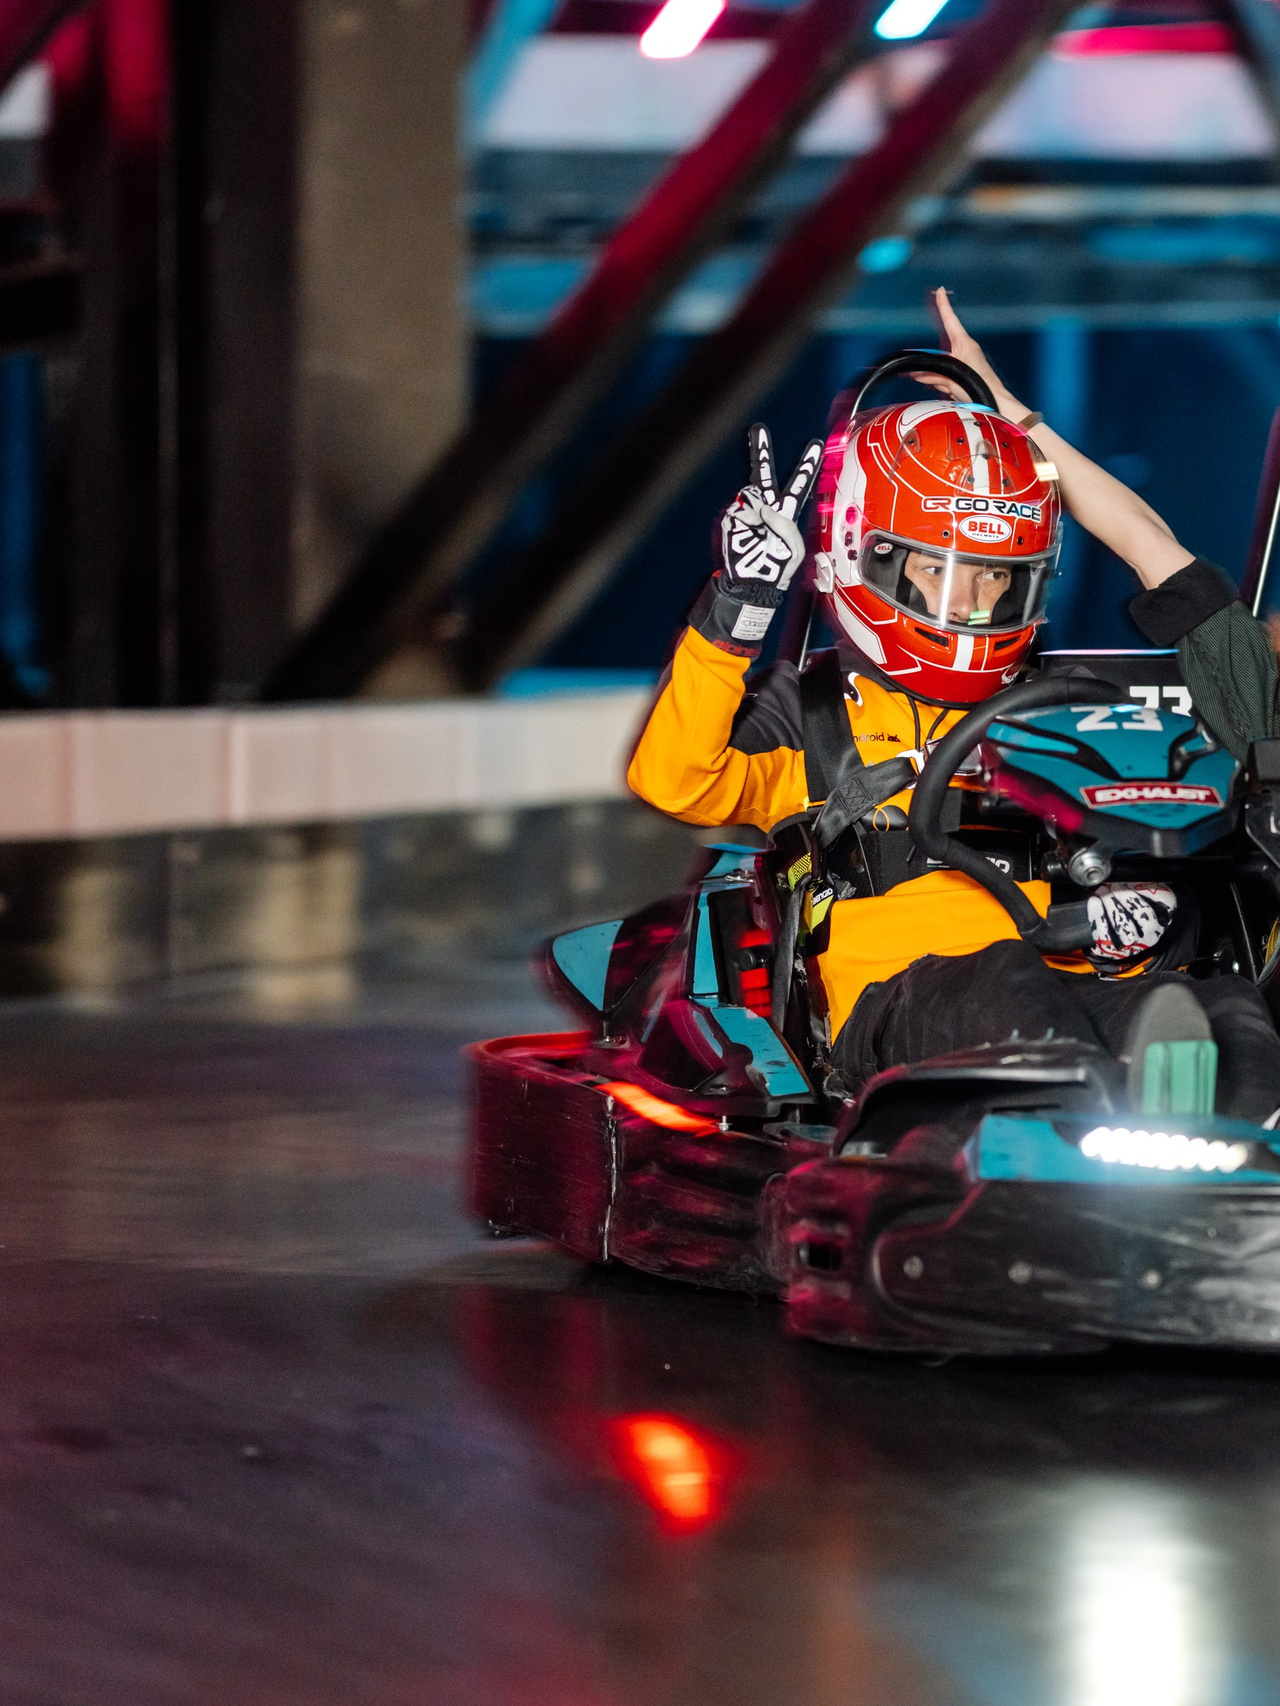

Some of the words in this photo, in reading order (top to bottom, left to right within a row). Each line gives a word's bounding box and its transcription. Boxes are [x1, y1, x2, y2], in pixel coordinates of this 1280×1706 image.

[955, 498, 989, 511] GO
[993, 500, 1041, 521] RACE
[968, 520, 1005, 535] BELL
[1070, 705, 1164, 732] 23
[853, 732, 885, 742] ndroid
[1094, 787, 1211, 803] EXHAUST
